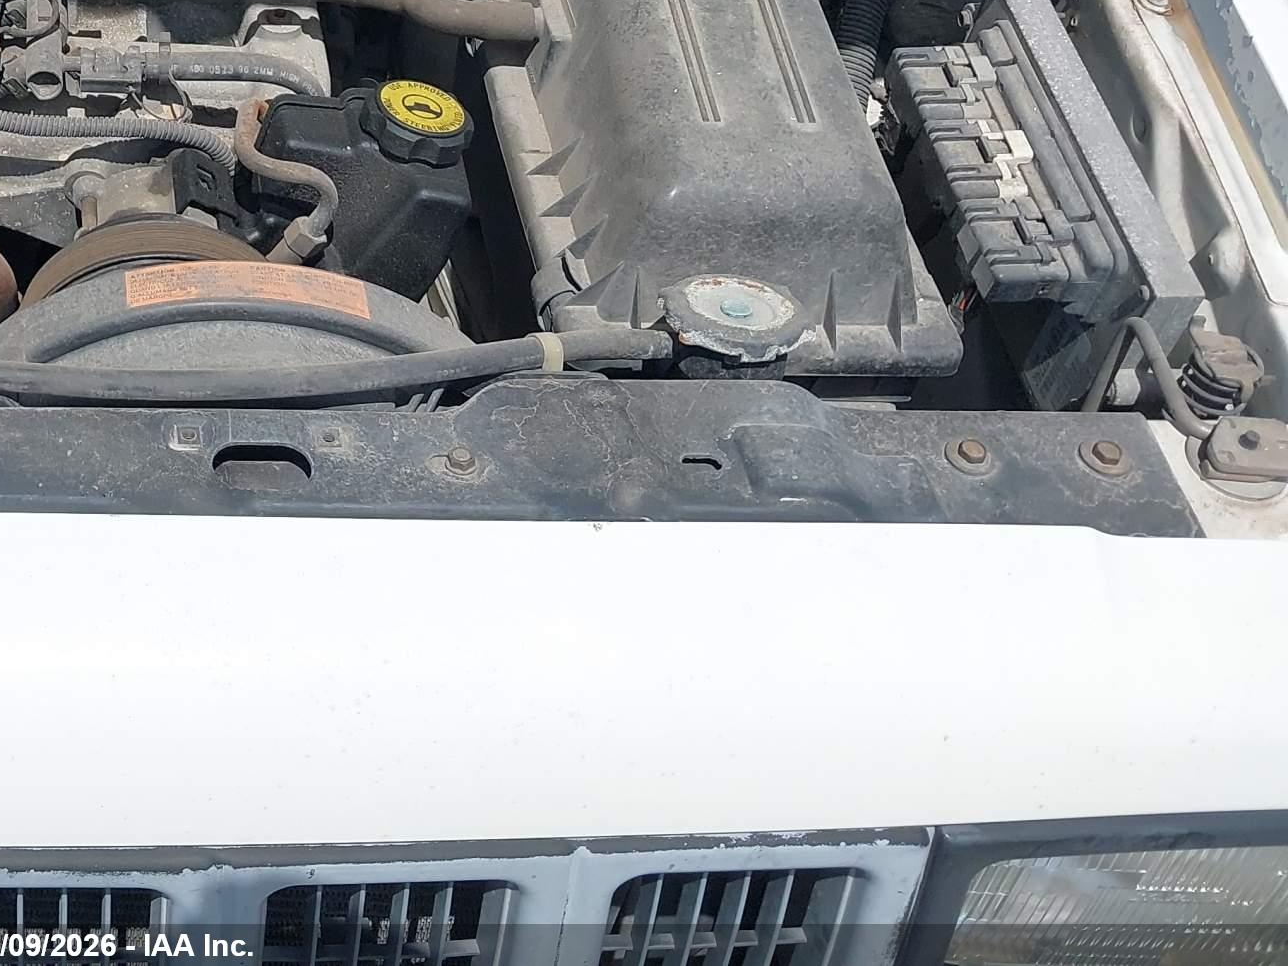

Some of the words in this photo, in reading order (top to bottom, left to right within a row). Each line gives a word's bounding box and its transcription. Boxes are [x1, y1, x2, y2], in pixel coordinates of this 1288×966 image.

[279, 71, 299, 84] HIGH
[387, 82, 404, 90] USE
[407, 82, 451, 102] APPROVED
[383, 97, 400, 116] POWER
[404, 117, 450, 131] STEERING
